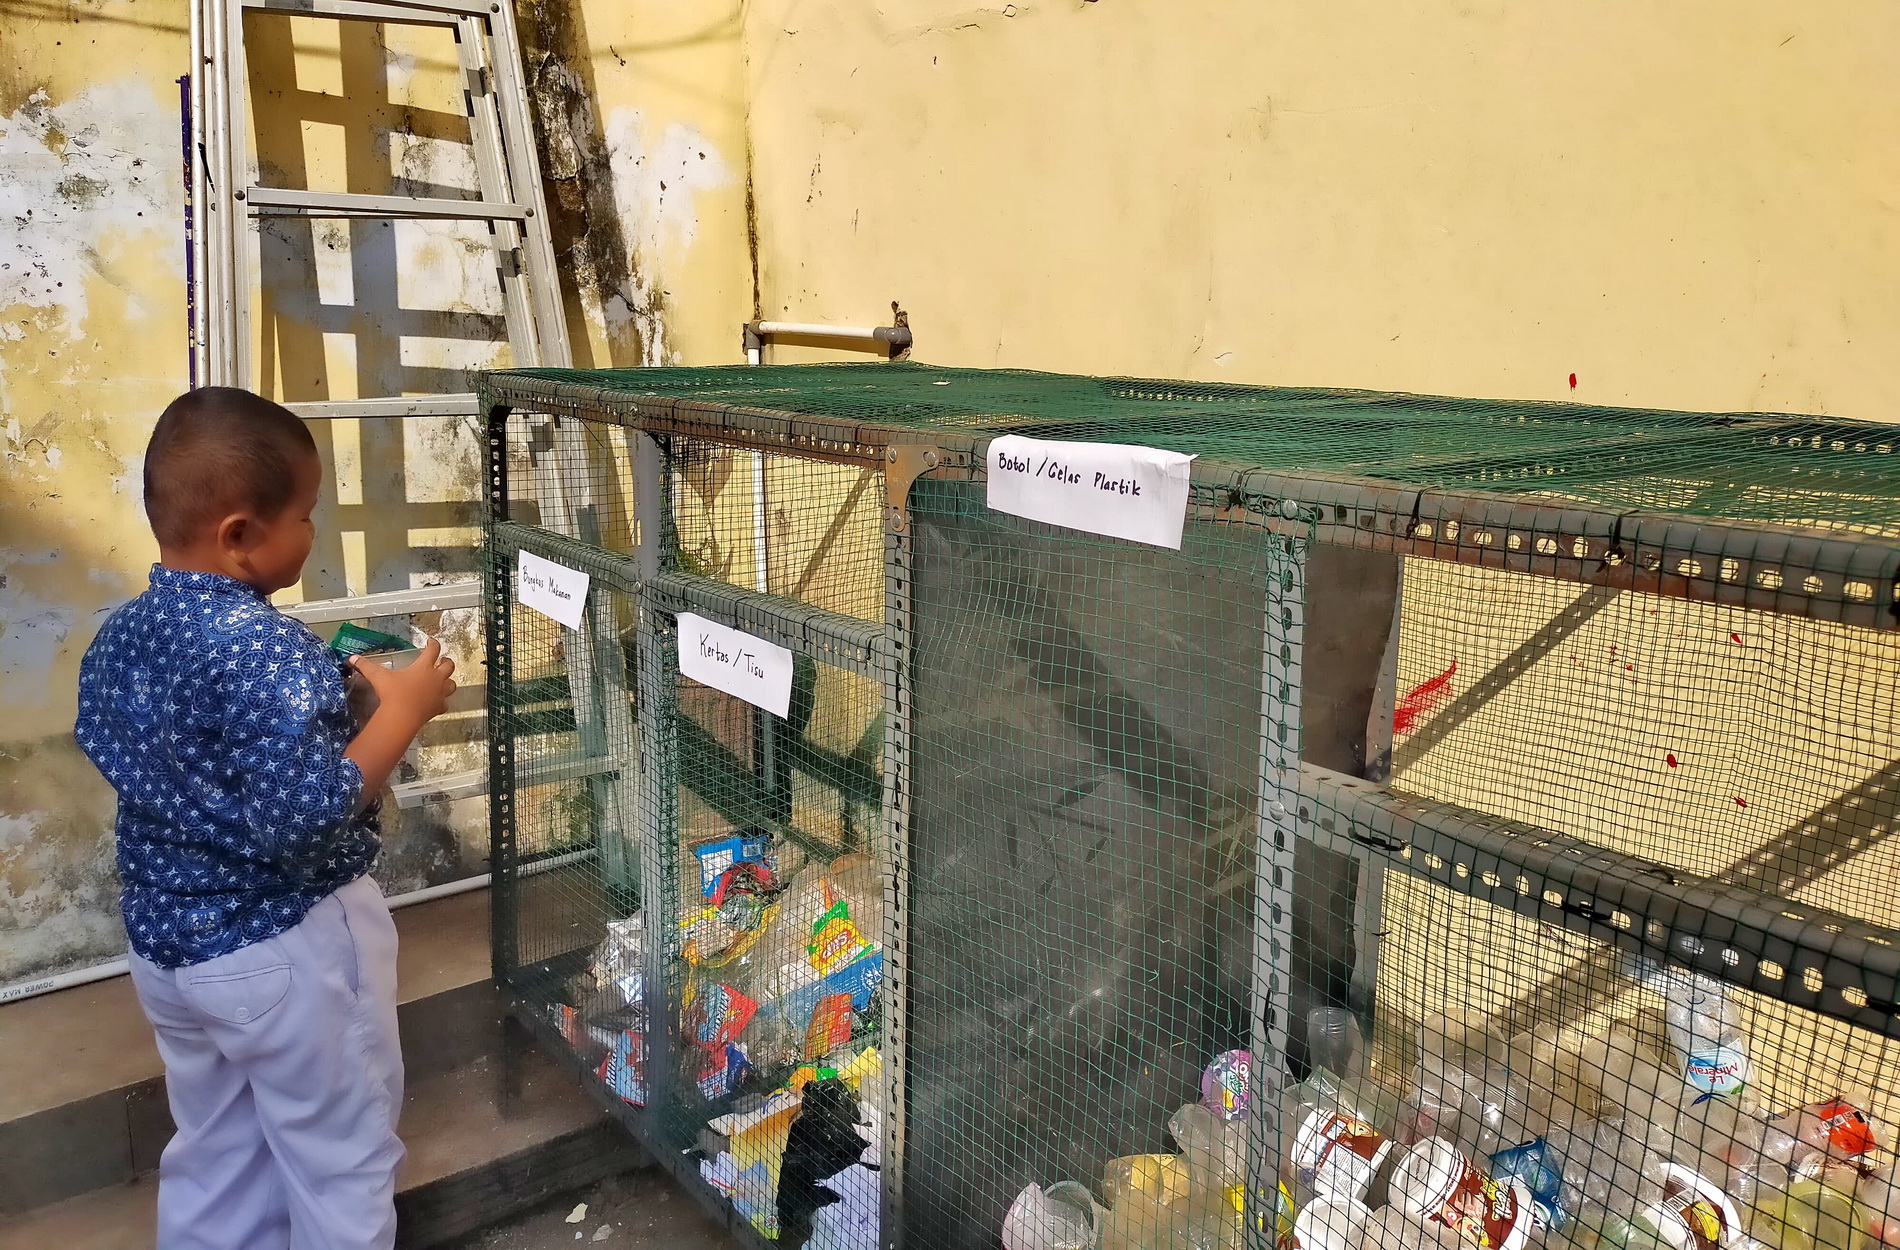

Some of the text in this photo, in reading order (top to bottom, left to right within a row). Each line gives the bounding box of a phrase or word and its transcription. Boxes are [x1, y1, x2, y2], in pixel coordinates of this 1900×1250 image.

[998, 452, 1030, 474] Botol
[1093, 471, 1141, 496] Plastik
[522, 565, 572, 601] Bungkus Makanan
[699, 633, 730, 664] Kertas
[2, 980, 54, 1000] POWER MAX
[1688, 1062, 1739, 1076] Minerale
[1708, 1075, 1725, 1086] Le
